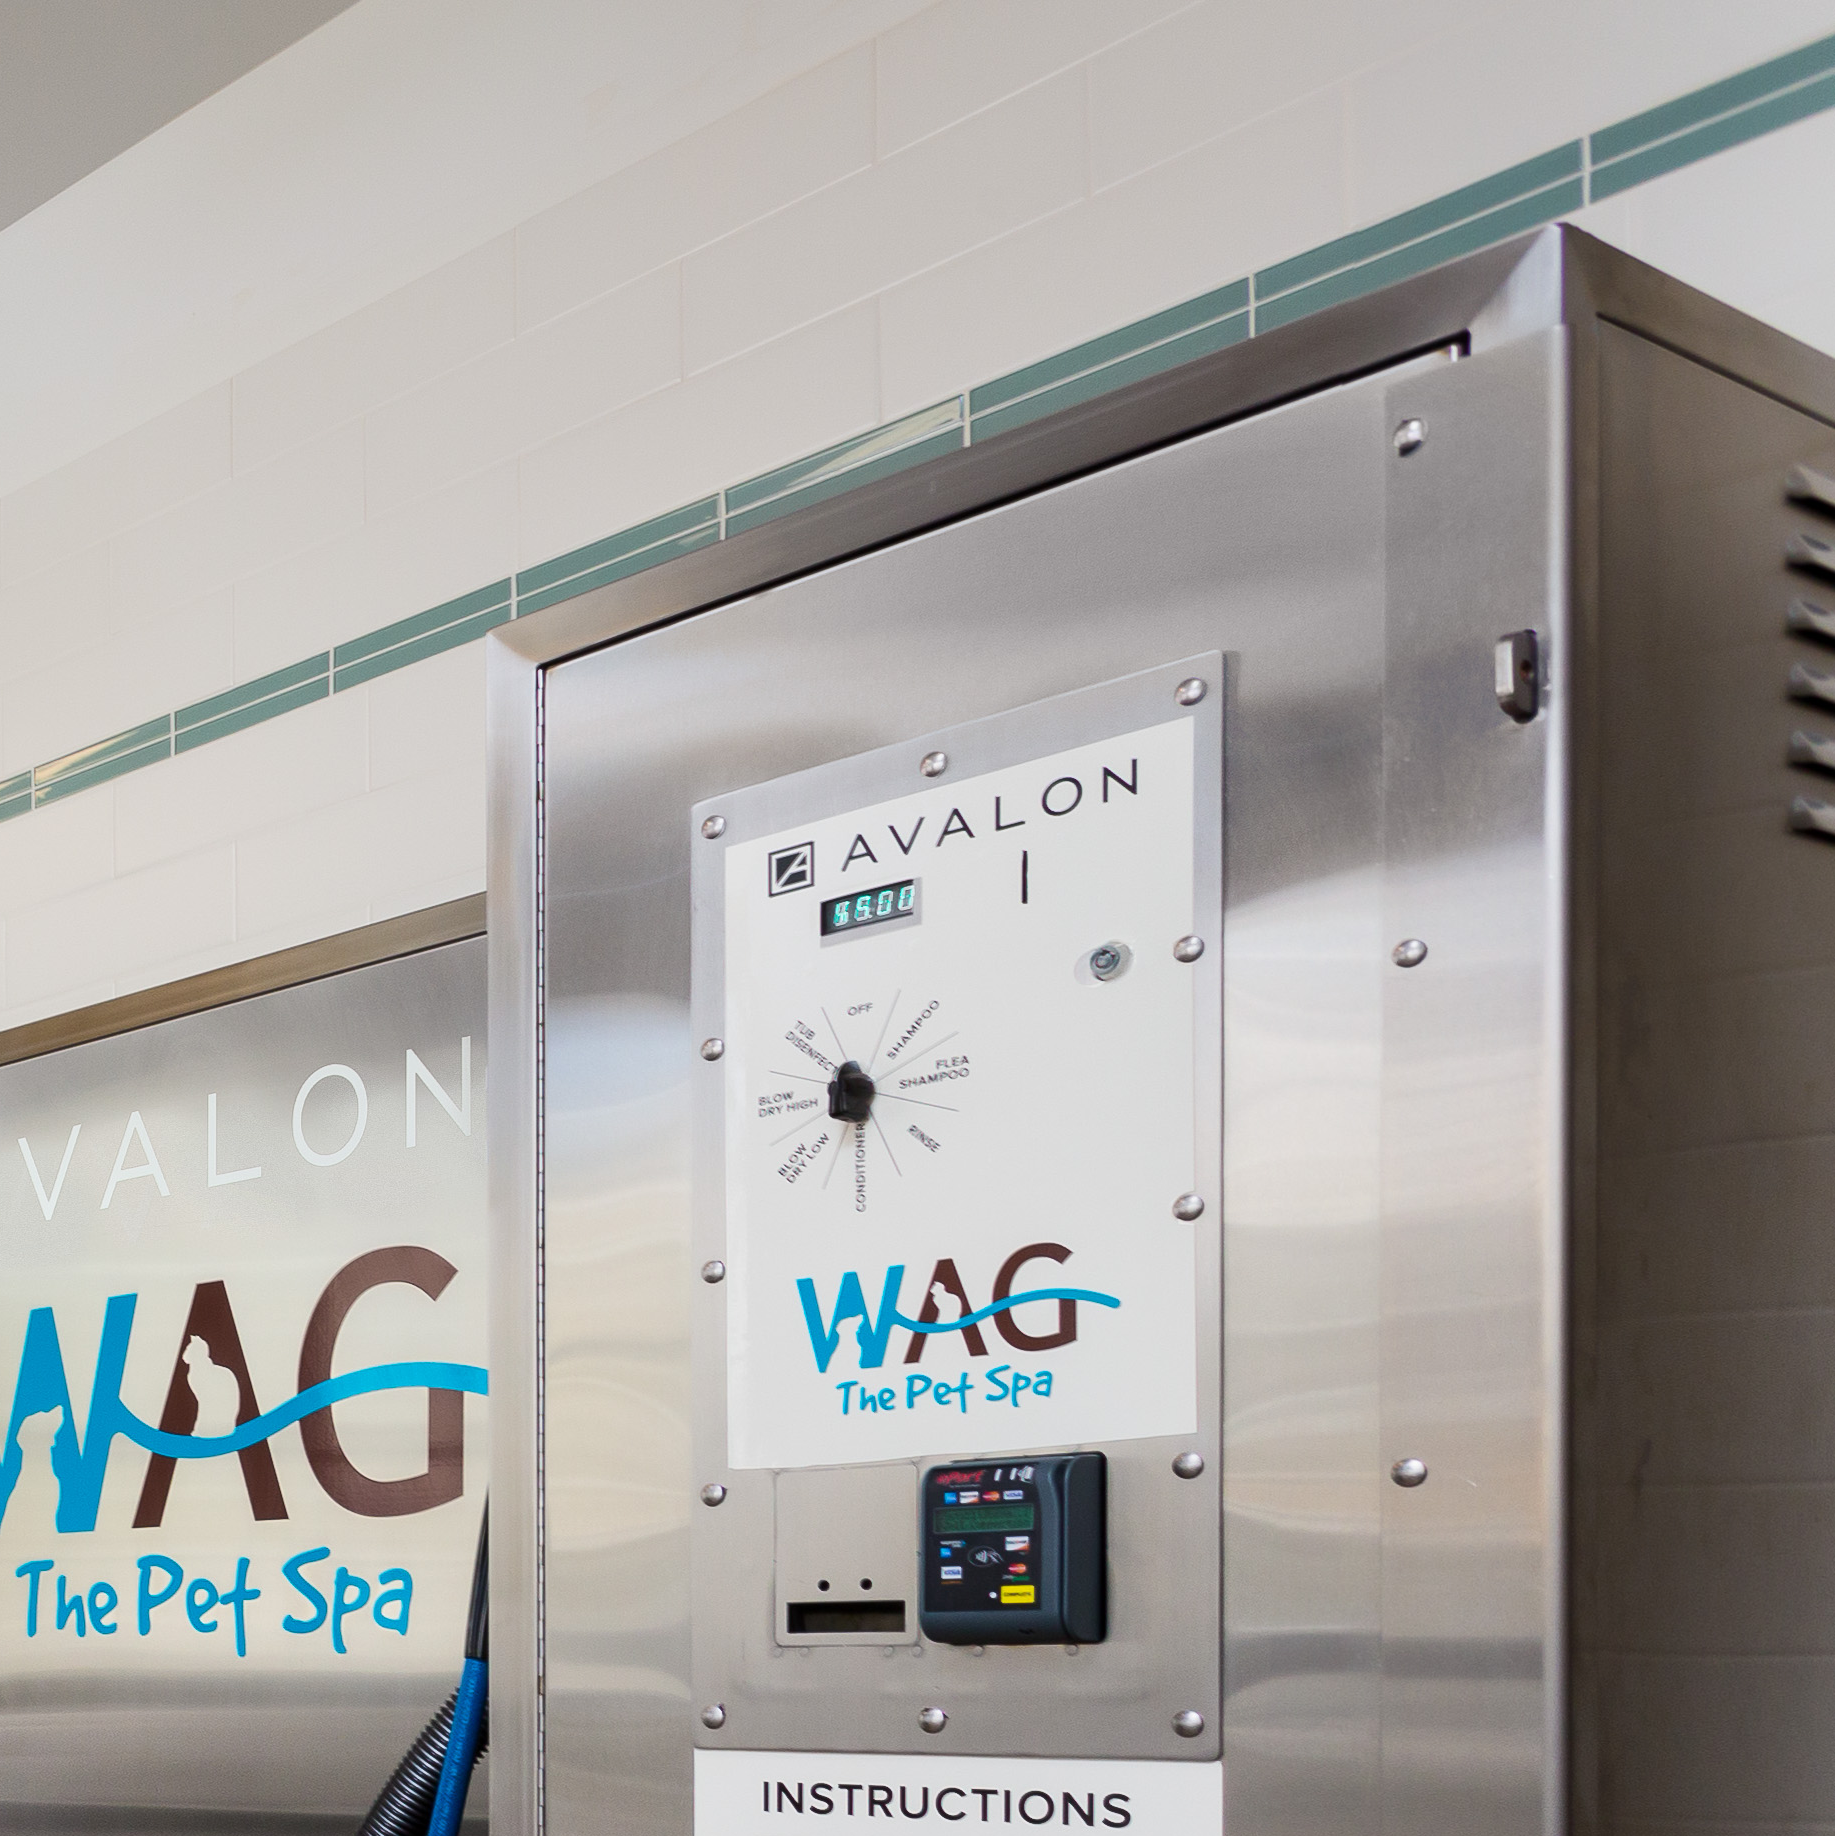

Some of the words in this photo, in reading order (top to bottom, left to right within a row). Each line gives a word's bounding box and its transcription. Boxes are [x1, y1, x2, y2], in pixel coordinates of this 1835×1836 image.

[840, 757, 1139, 873] AVALON
[847, 1002, 874, 1016] OFF
[794, 1020, 816, 1041] TUB
[886, 1000, 940, 1060] SHAMPOO
[898, 1067, 970, 1090] SHAMPOO
[935, 1055, 970, 1070] FLEA
[758, 1091, 794, 1107] BLOW
[758, 1105, 784, 1118] DRY
[786, 1098, 819, 1112] HIGH
[785, 1159, 808, 1184] DRY
[805, 1132, 830, 1160] LOW
[906, 1124, 941, 1153] RINSE
[777, 1143, 808, 1177] BLOW
[855, 1121, 867, 1213] CONDITIONER
[796, 1242, 1081, 1375] WAG
[836, 1379, 896, 1417] The
[906, 1371, 974, 1417] Pet
[985, 1362, 1054, 1408] Spa
[15, 1559, 119, 1638] The
[137, 1554, 262, 1658] Pet
[281, 1546, 414, 1655] Spa
[763, 1781, 1132, 1829] INSTRUCTIONS
